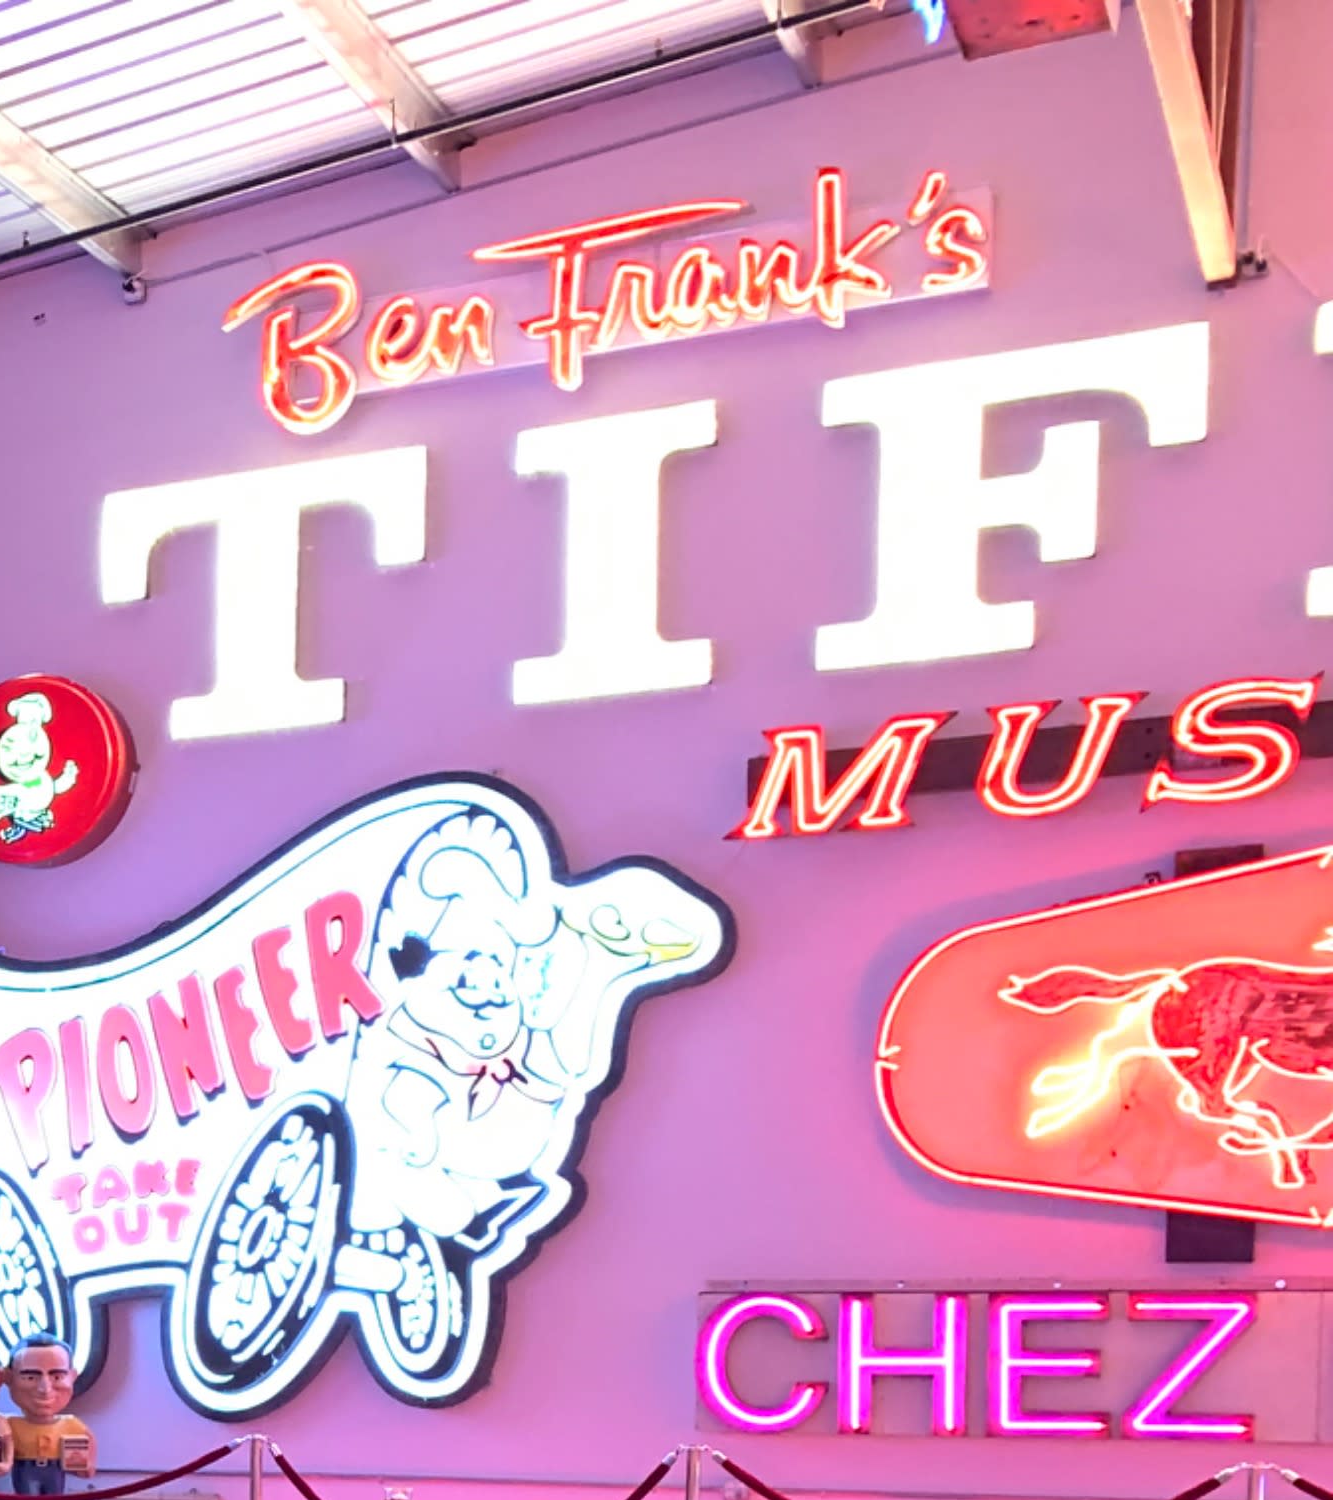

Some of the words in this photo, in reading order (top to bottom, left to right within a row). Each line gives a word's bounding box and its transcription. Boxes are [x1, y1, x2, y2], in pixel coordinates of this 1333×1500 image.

[221, 260, 495, 436] Ben
[469, 166, 987, 391] Frank's
[100, 320, 1333, 742] TIF
[51, 1157, 202, 1215] TAKE
[72, 1202, 192, 1255] OUT
[695, 1294, 1259, 1437] CHEZ
